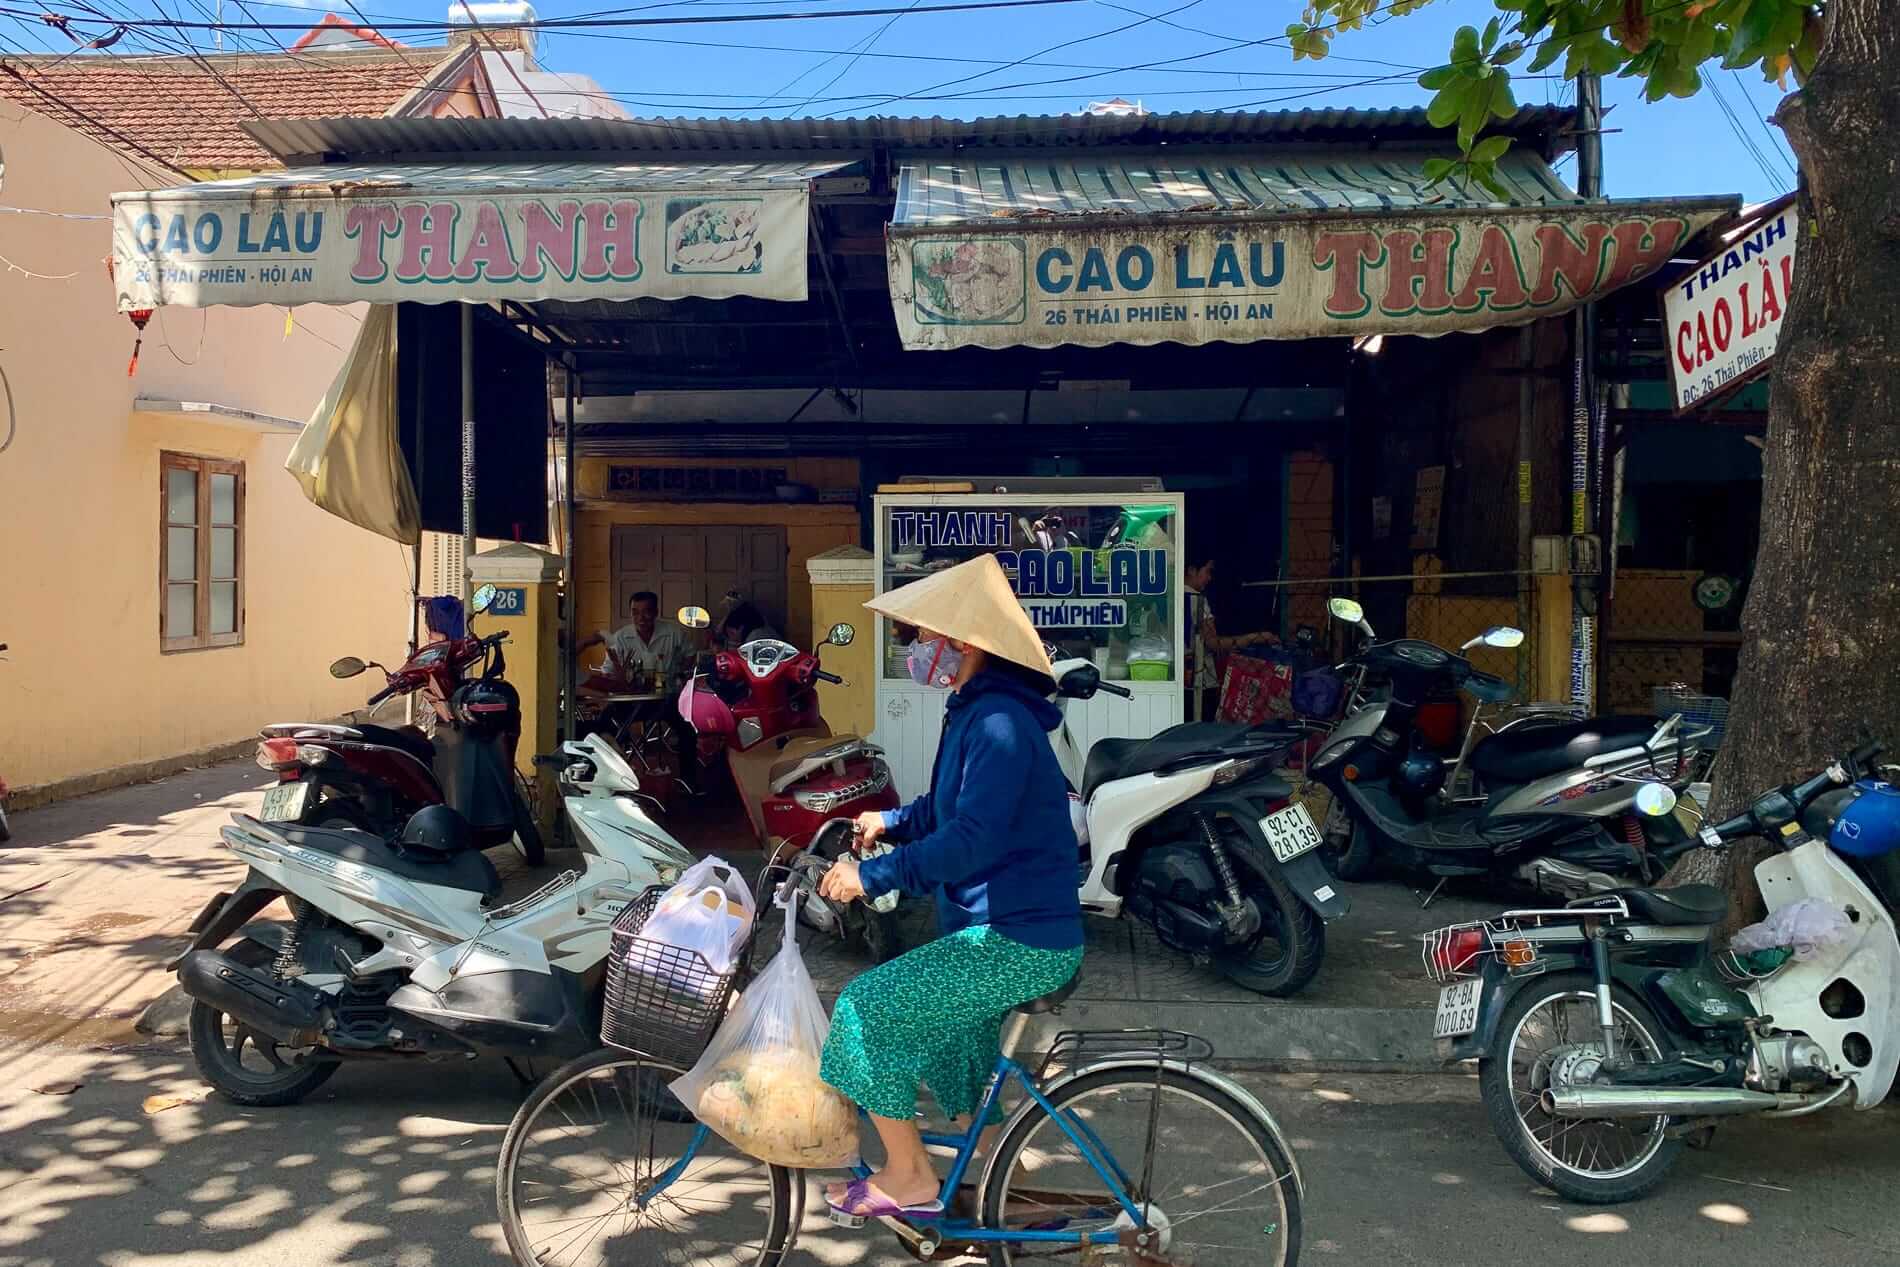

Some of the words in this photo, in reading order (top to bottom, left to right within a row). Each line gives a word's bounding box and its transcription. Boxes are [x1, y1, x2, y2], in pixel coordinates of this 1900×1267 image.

[135, 211, 223, 254] CAO
[344, 198, 645, 284] THANH
[198, 265, 246, 283] PHIÊN
[260, 265, 286, 286] HỘI
[291, 267, 313, 283] AN
[1035, 244, 1154, 294] CAO
[1312, 217, 1690, 319] THANH
[1681, 216, 1786, 301] THANH
[1045, 310, 1067, 325] 26
[1073, 304, 1120, 325] THÁI
[1127, 302, 1187, 323] PHIÊN
[1206, 301, 1239, 325] HỘI
[1246, 303, 1273, 319] AN
[1677, 298, 1732, 375] CAO
[1702, 375, 1714, 396] 26
[1715, 361, 1736, 382] Thái
[1737, 346, 1766, 372] Phiên
[891, 512, 1012, 546] THANH
[995, 548, 1074, 597] CAO
[496, 590, 517, 609] 26
[1030, 600, 1068, 625] THÁI
[1070, 602, 1124, 625] PHIÊN
[1274, 825, 1318, 858] 281.39
[1437, 1008, 1474, 1034] 000.69
